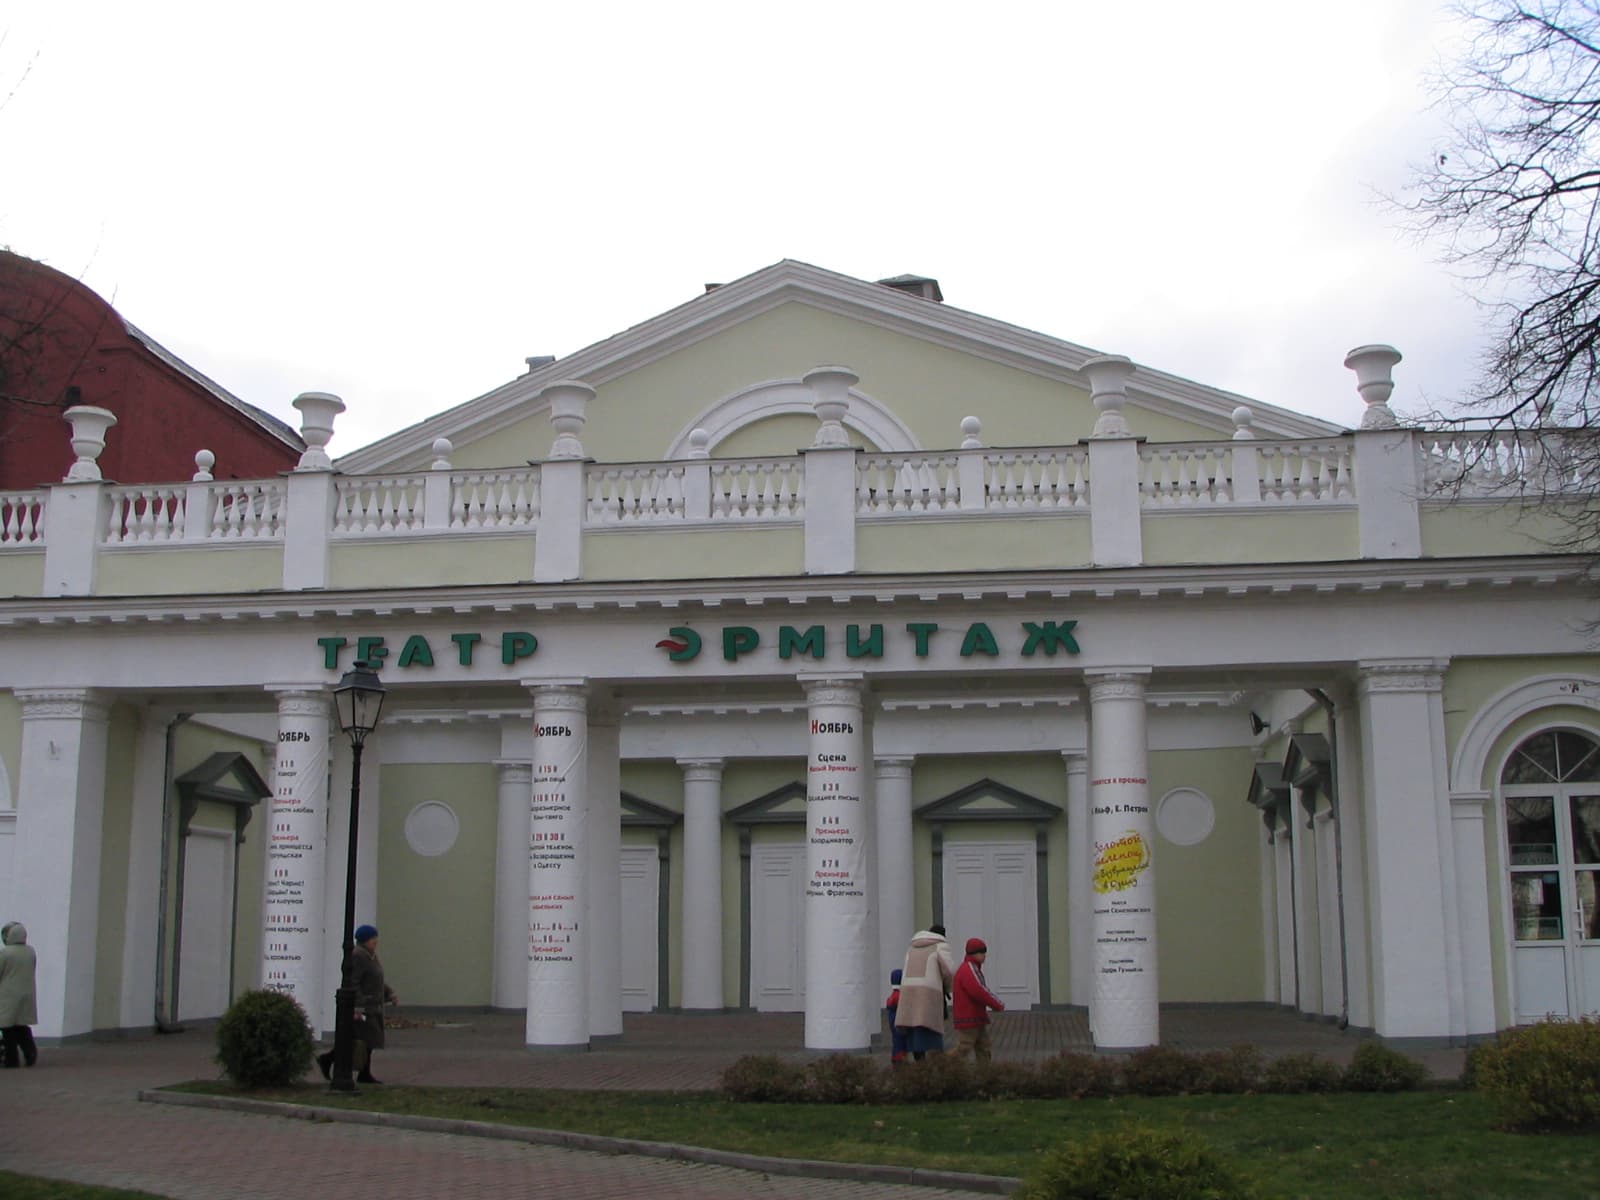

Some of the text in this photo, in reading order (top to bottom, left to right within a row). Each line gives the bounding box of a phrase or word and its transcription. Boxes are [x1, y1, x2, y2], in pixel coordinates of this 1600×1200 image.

[317, 620, 1080, 669] ТЕАТР ЭРМИТАЖ
[817, 753, 847, 763] Сцена
